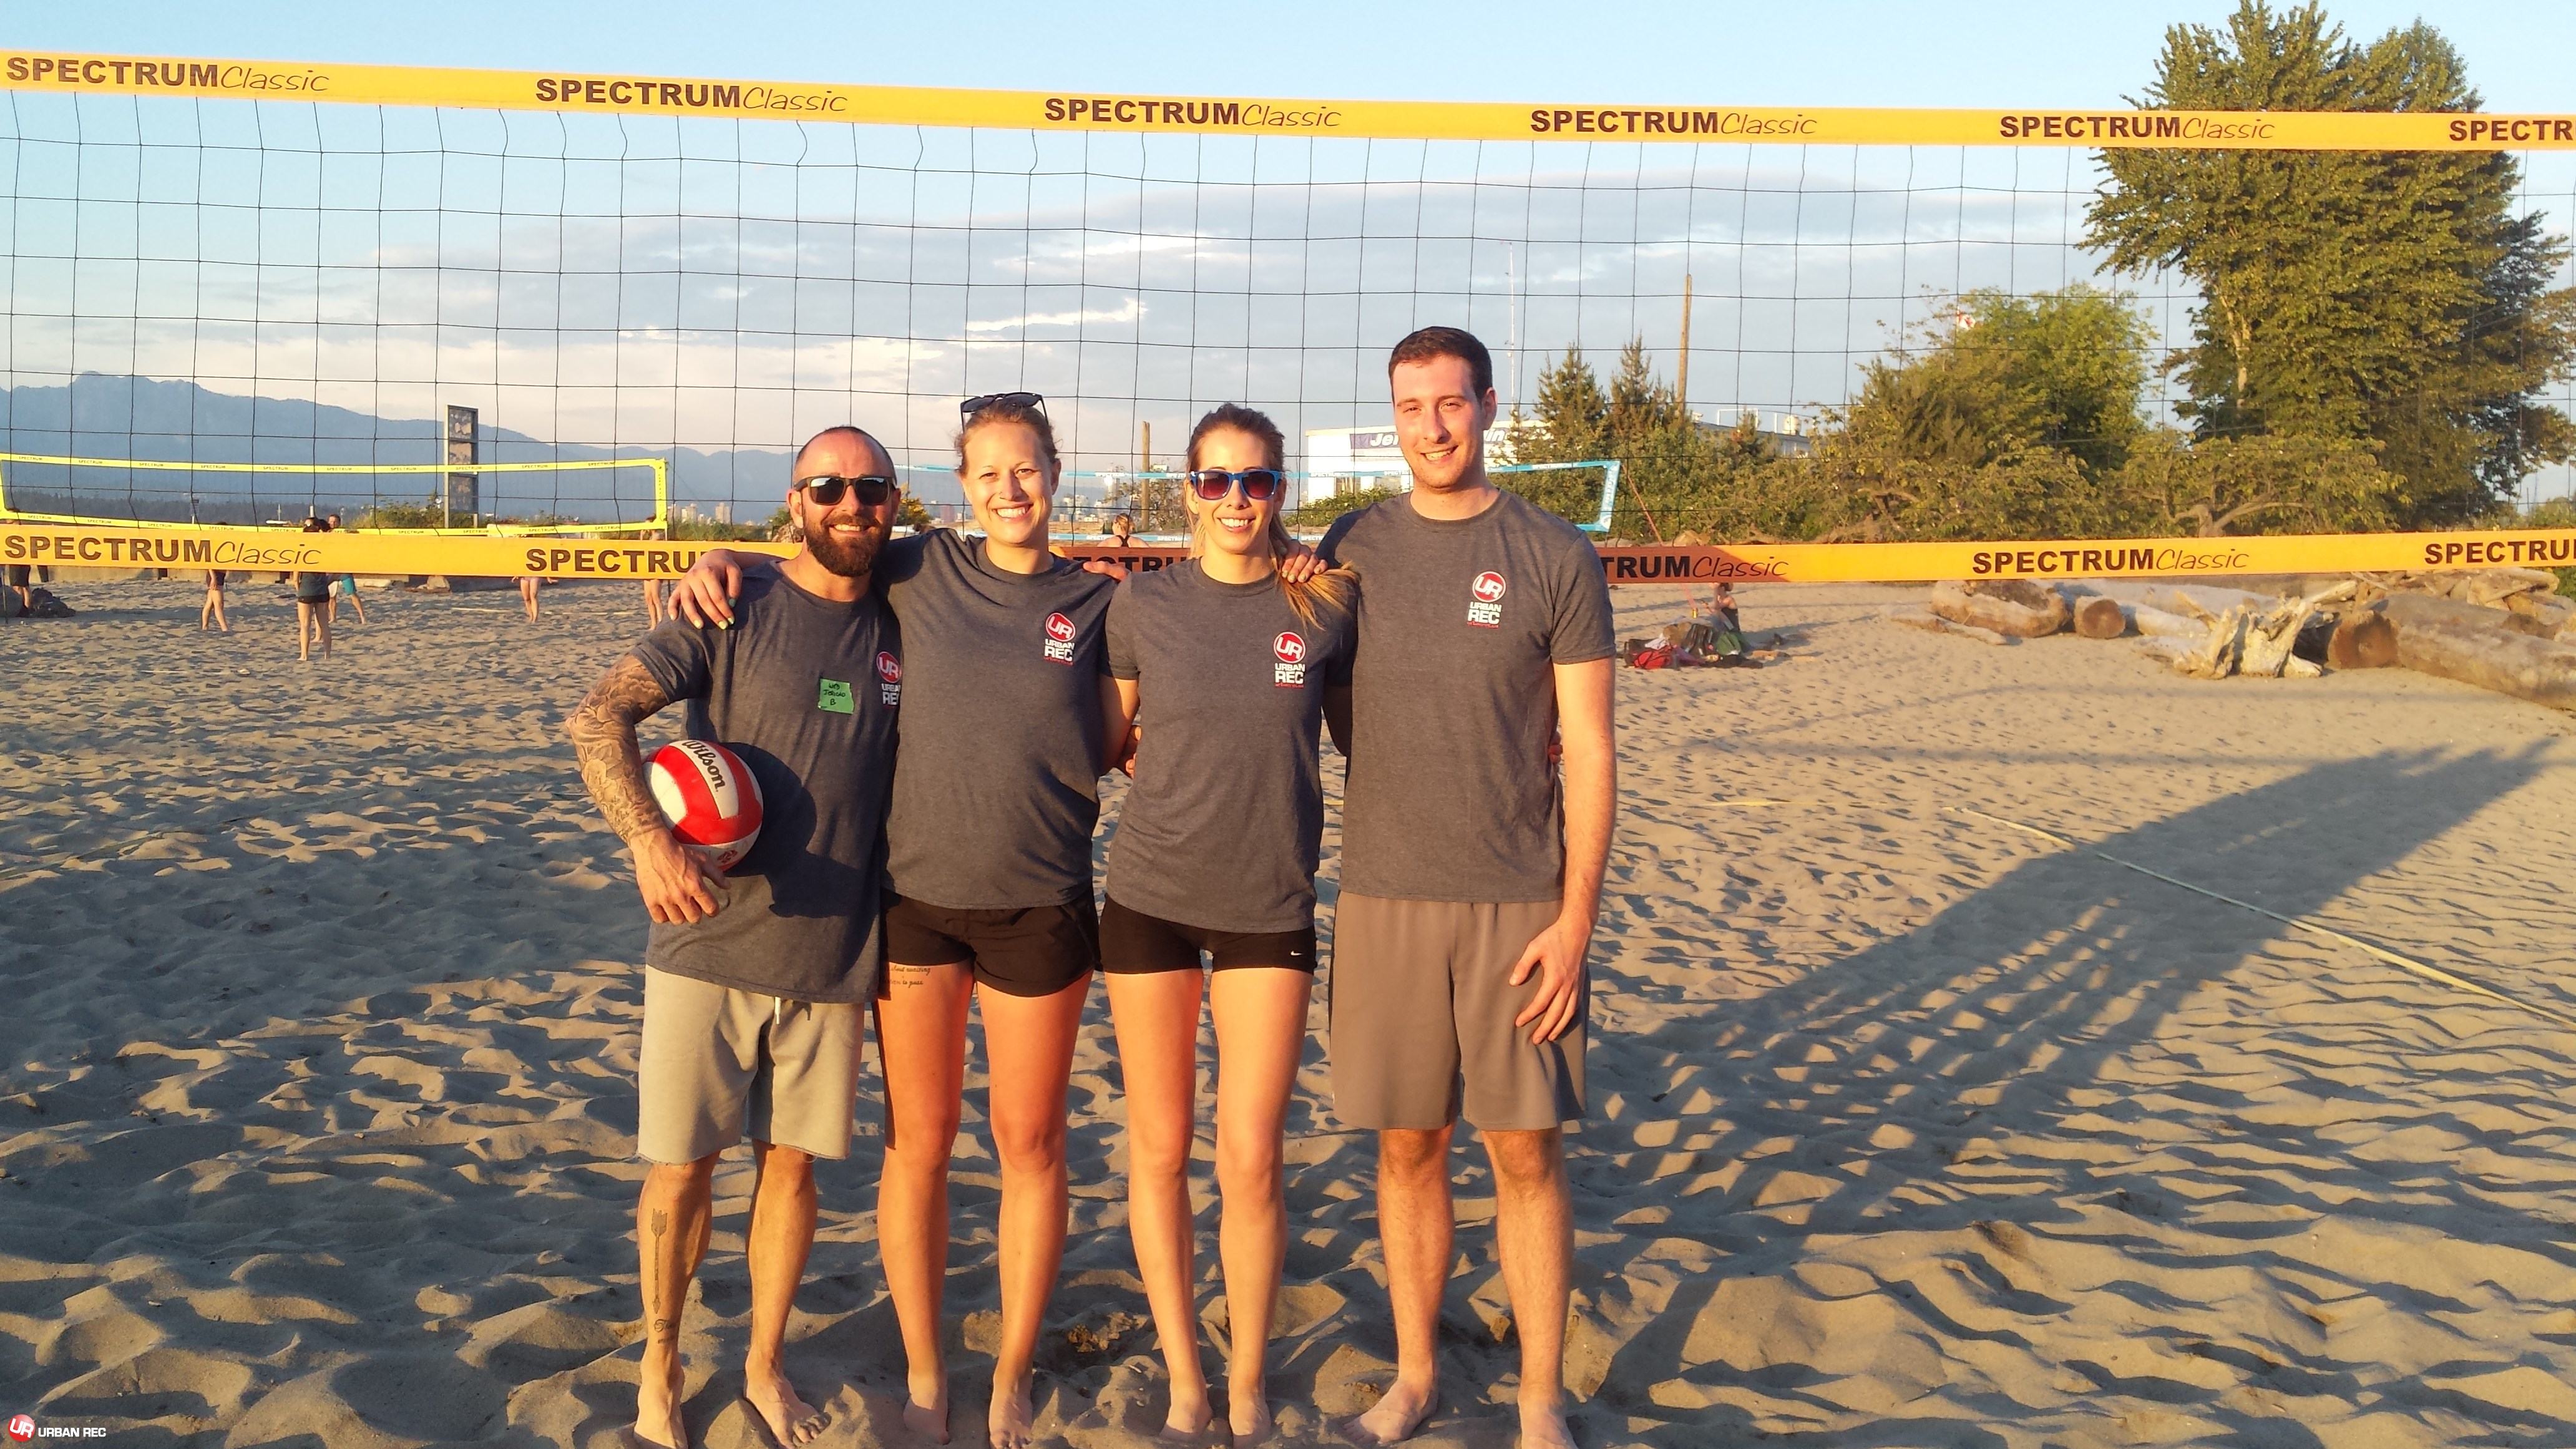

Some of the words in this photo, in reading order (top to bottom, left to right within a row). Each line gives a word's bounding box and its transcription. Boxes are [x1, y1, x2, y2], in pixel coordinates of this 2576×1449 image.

[2449, 120, 2576, 141] SPECTR
[2425, 539, 2576, 564] SPECTRU
[526, 549, 708, 573] SPECTRU
[1601, 557, 1690, 578] TRUM
[1470, 602, 1502, 612] URBAN
[1468, 609, 1500, 625] REC
[1045, 638, 1075, 650] URBAN
[1044, 645, 1073, 661] REC
[1275, 663, 1305, 672] URBAN
[1275, 671, 1304, 684] REC
[681, 740, 726, 789] Wilson
